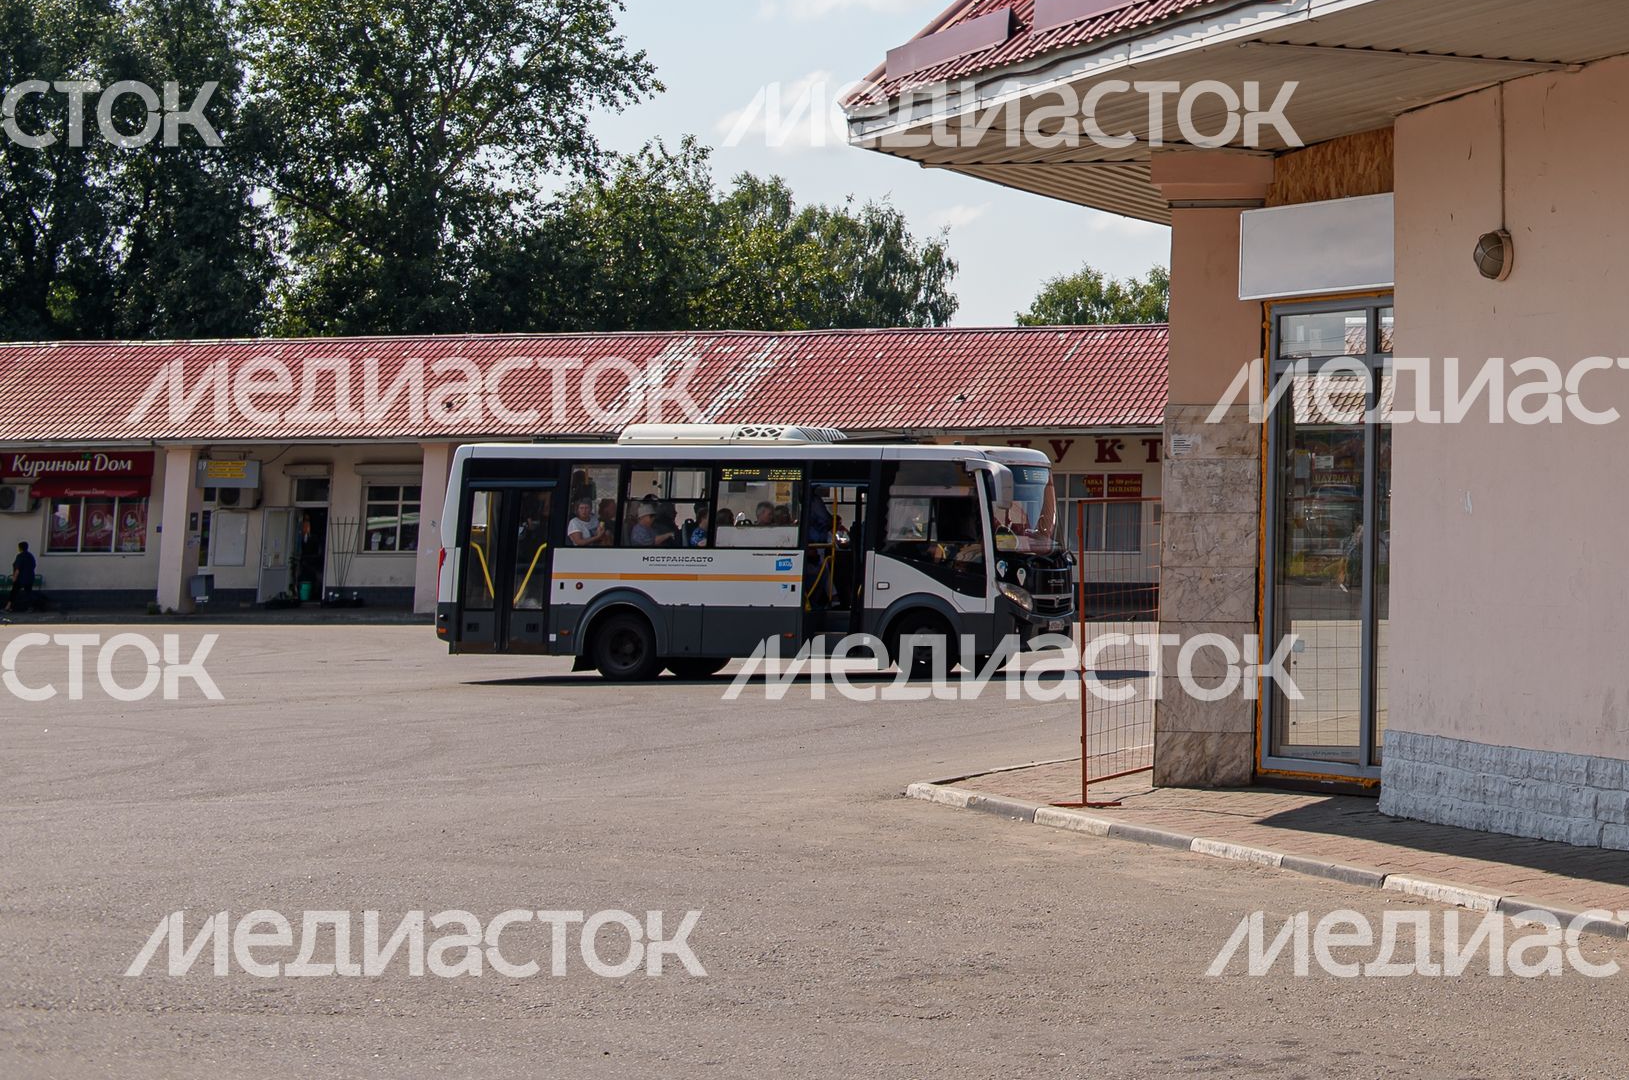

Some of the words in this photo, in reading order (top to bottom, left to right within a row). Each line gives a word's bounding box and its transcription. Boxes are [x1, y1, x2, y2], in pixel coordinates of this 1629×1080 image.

[1007, 439, 1162, 463] УКТ
[12, 454, 90, 477] Куриный
[94, 453, 132, 471] Дом
